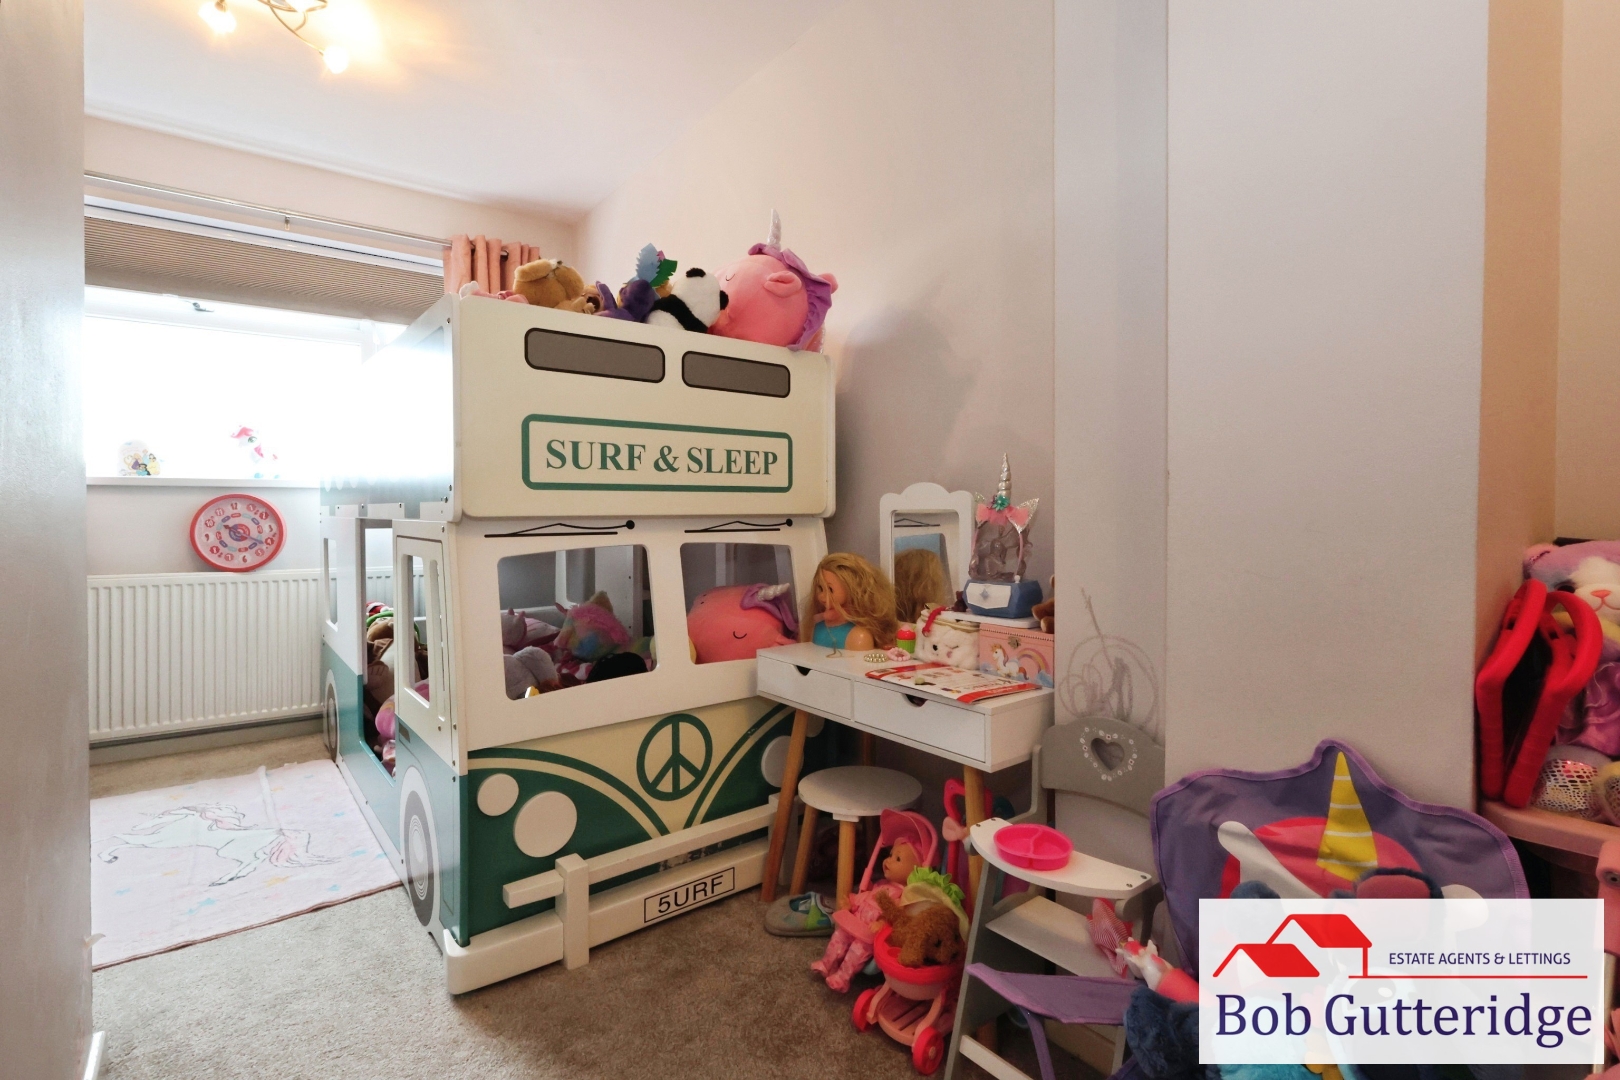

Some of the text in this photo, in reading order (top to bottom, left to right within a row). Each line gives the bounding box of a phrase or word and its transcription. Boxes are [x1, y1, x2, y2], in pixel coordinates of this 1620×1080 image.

[545, 439, 778, 475] SURF & SLEEP
[230, 502, 238, 510] 12
[216, 508, 223, 516] 11
[205, 520, 214, 528] 10
[658, 875, 723, 913] 5URF
